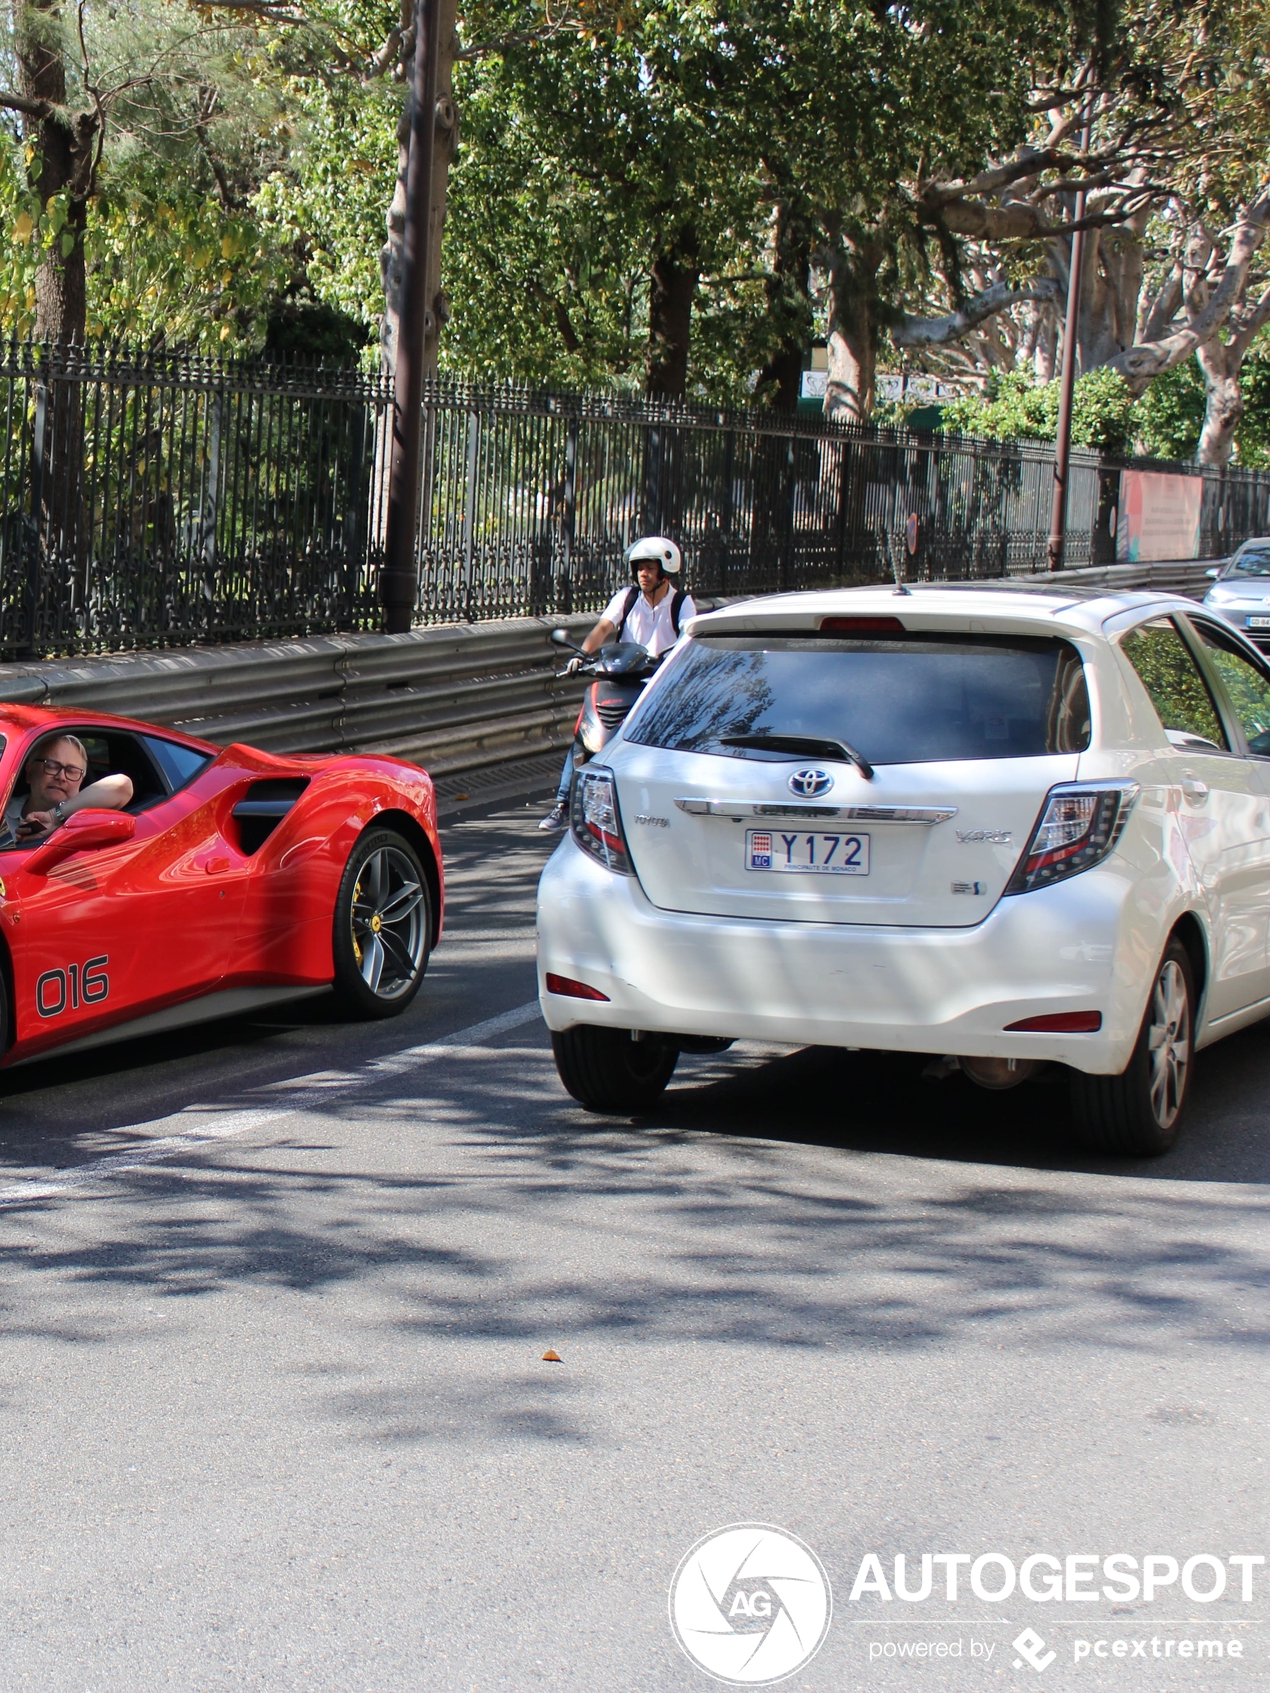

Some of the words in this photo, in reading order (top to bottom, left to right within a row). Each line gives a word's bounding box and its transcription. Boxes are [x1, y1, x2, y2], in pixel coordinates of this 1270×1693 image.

[786, 641, 815, 649] Toyota
[838, 639, 862, 647] Made
[873, 640, 903, 648] France
[781, 834, 861, 866] Y172
[754, 855, 769, 866] MC
[831, 865, 857, 873] MONACO
[35, 953, 110, 1019] 016
